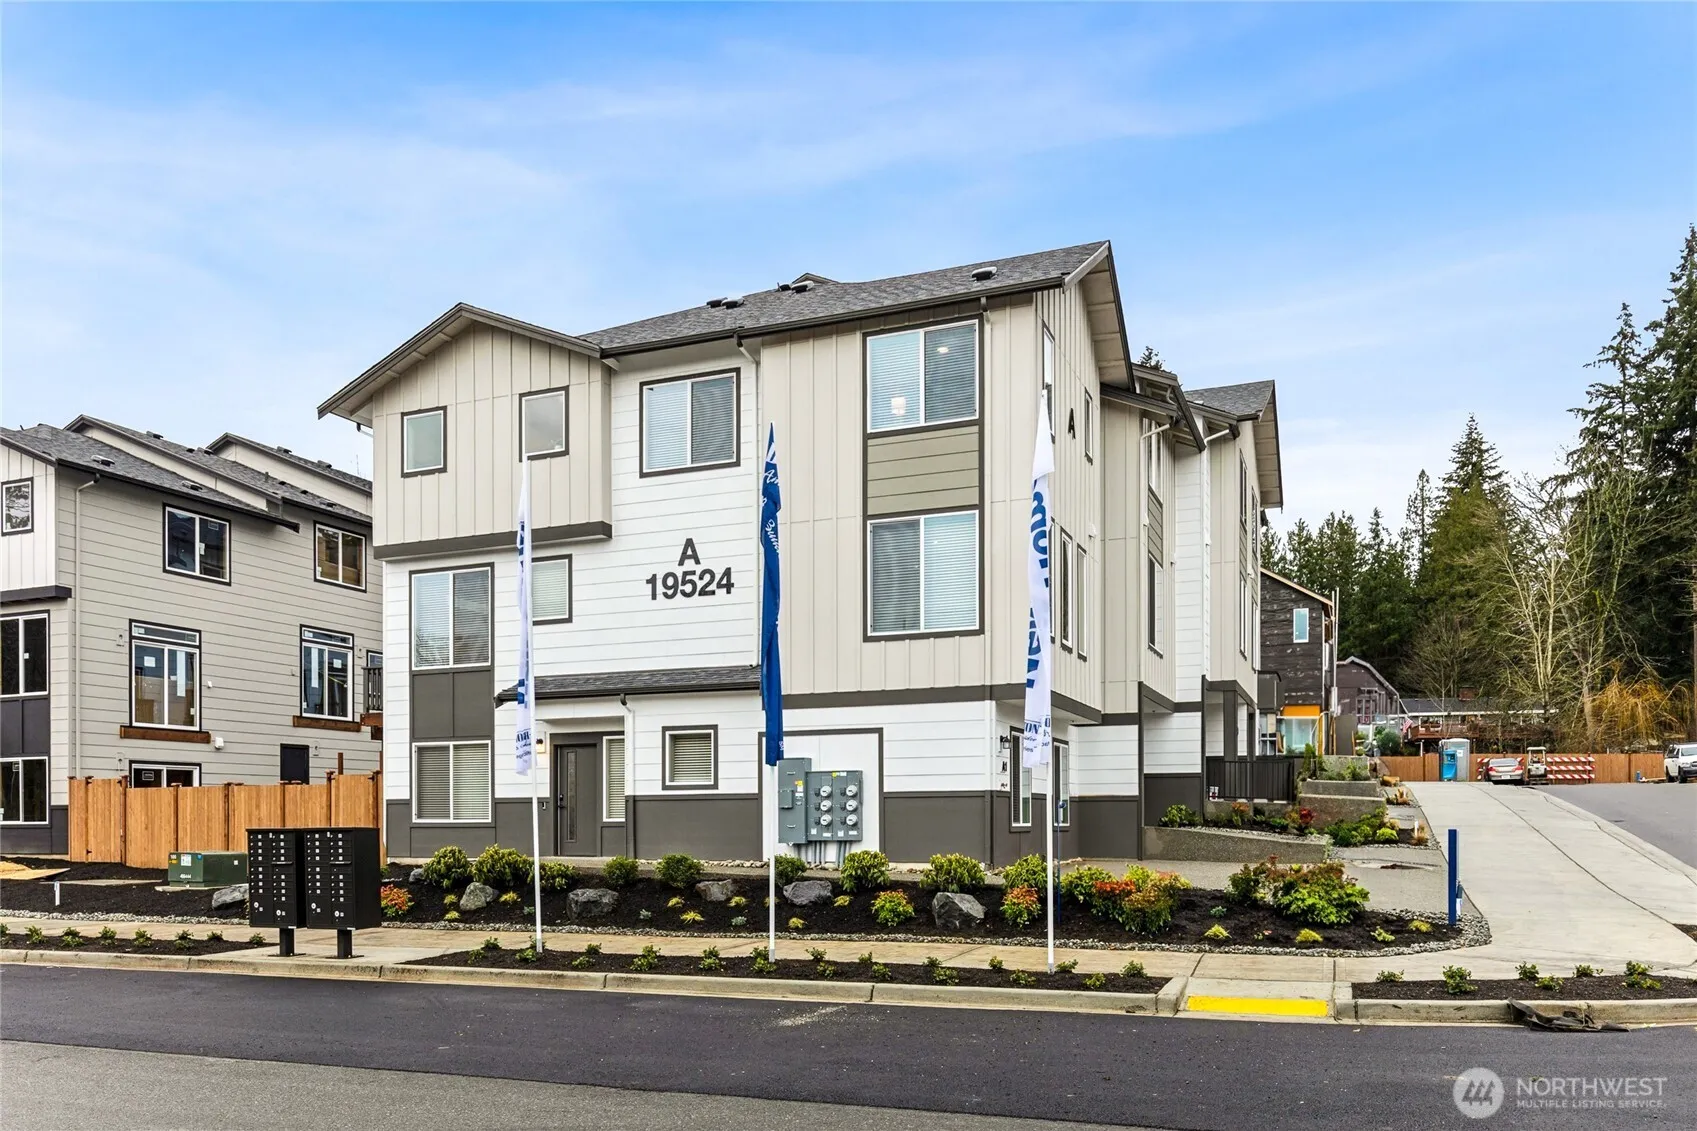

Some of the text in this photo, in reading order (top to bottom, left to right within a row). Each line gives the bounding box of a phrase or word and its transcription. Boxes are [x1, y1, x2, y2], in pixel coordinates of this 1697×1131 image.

[1067, 408, 1076, 440] A
[678, 538, 701, 566] A
[645, 567, 735, 601] 19524
